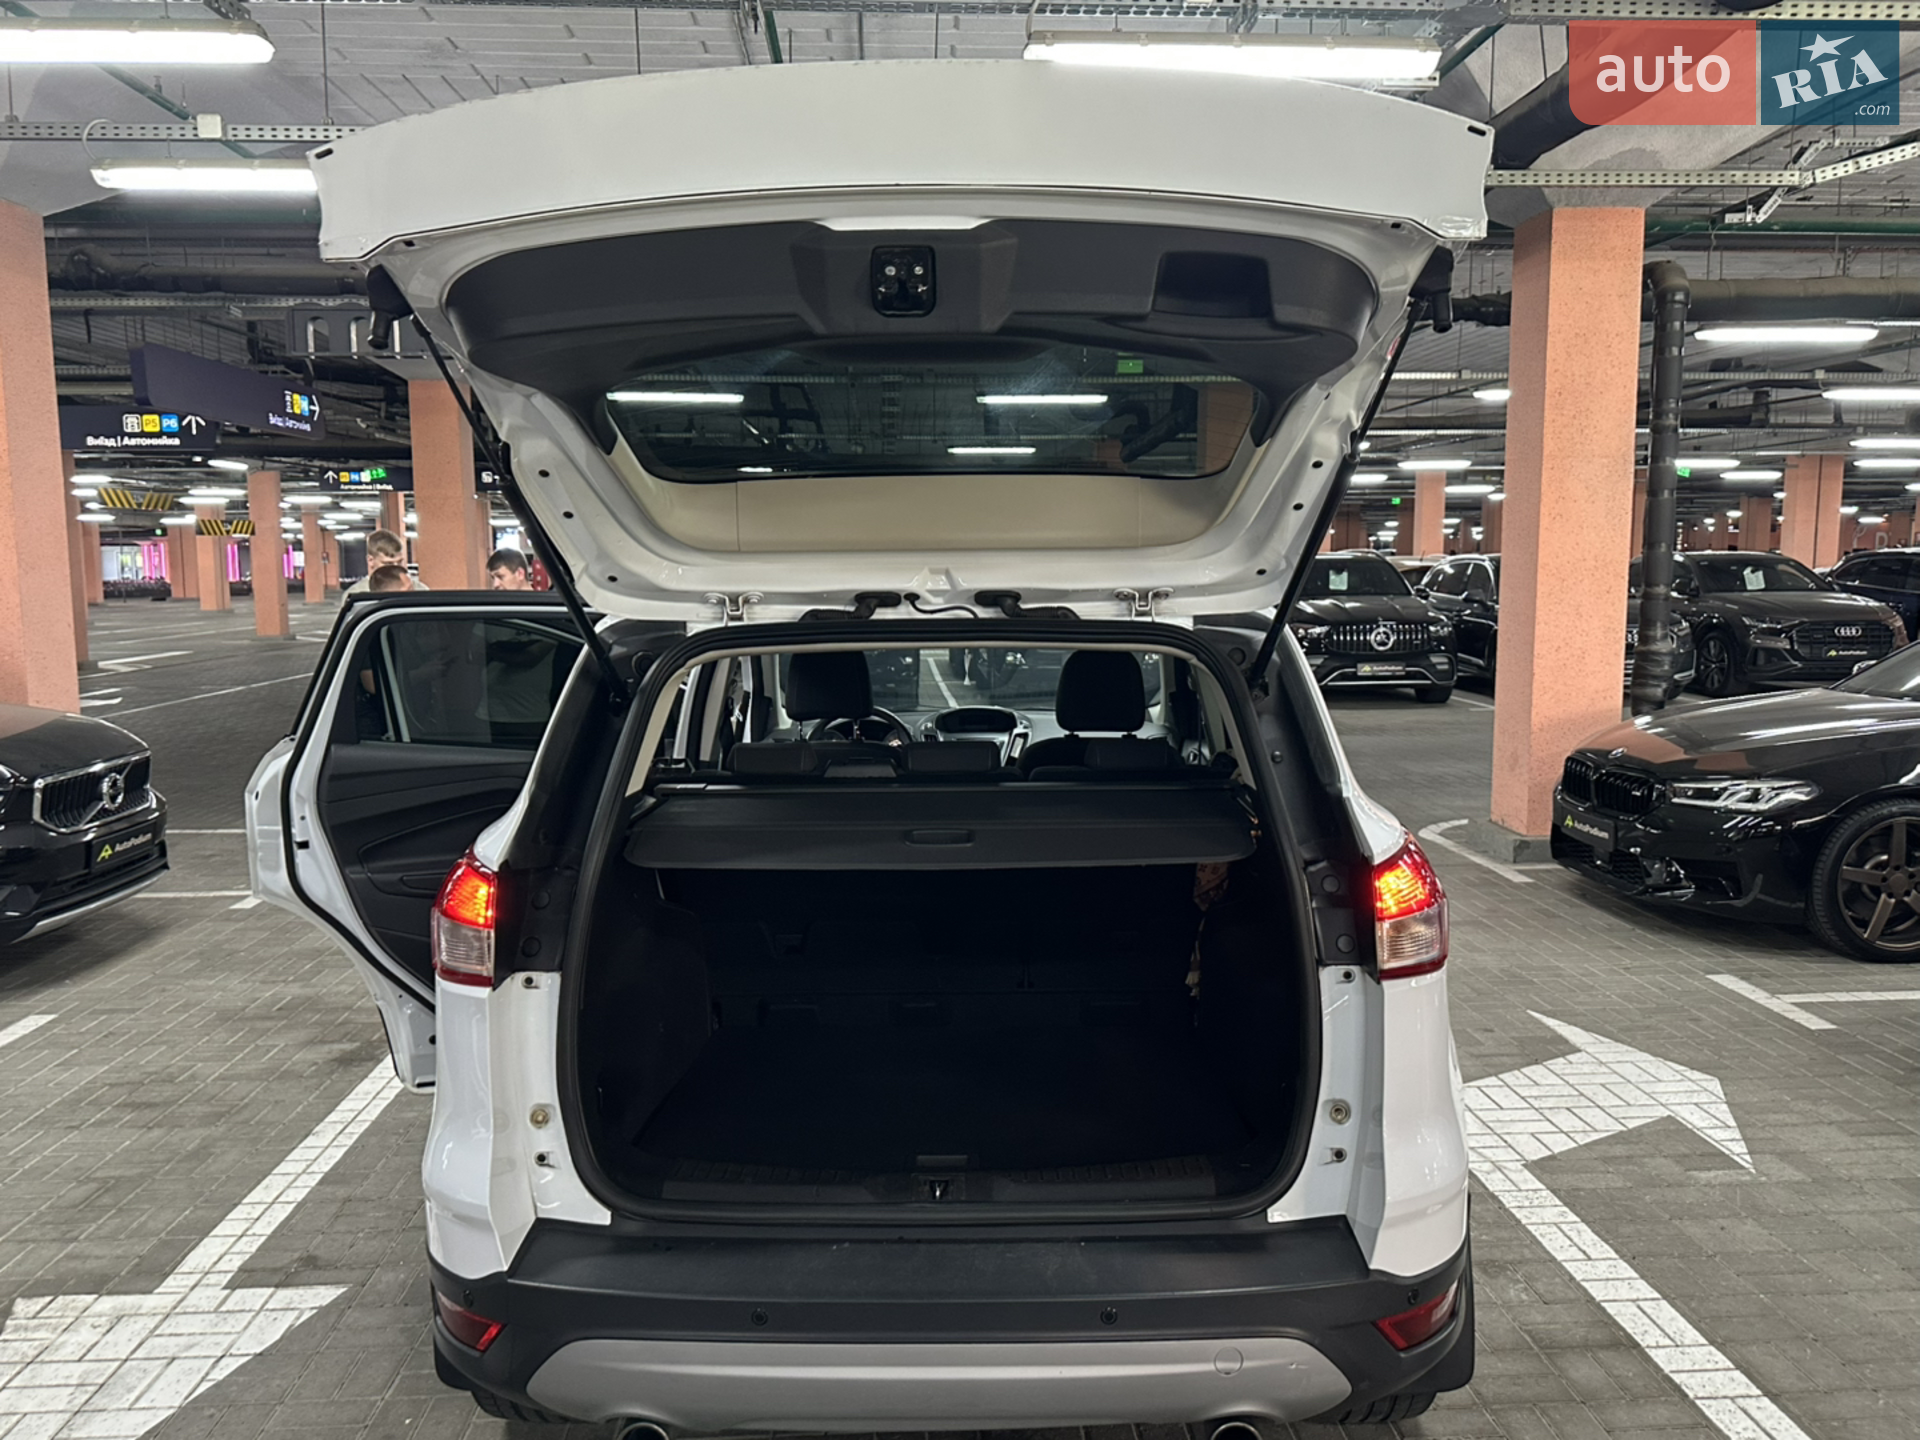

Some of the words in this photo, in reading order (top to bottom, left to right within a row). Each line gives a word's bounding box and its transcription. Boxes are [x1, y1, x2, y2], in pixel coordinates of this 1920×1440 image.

[122, 435, 181, 446] Автомийка
[1574, 819, 1610, 840] AutoPodium
[114, 832, 152, 853] AutoPodium
